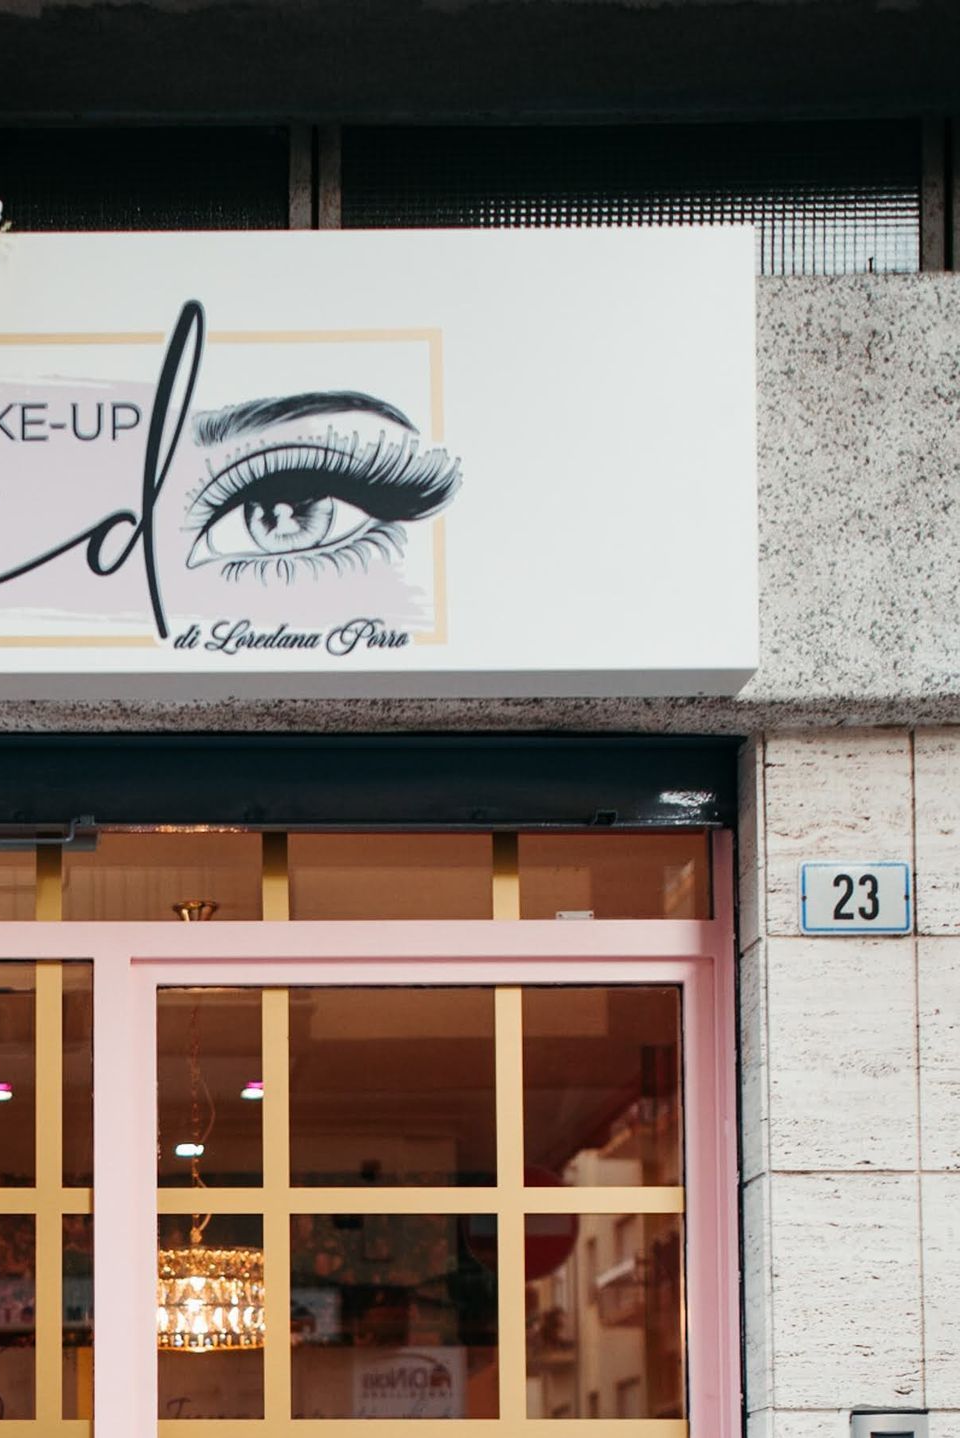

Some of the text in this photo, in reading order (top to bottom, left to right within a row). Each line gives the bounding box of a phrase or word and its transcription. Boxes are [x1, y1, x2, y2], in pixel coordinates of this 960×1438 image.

[173, 618, 409, 656] di Loredana Porro
[833, 874, 879, 920] 23
